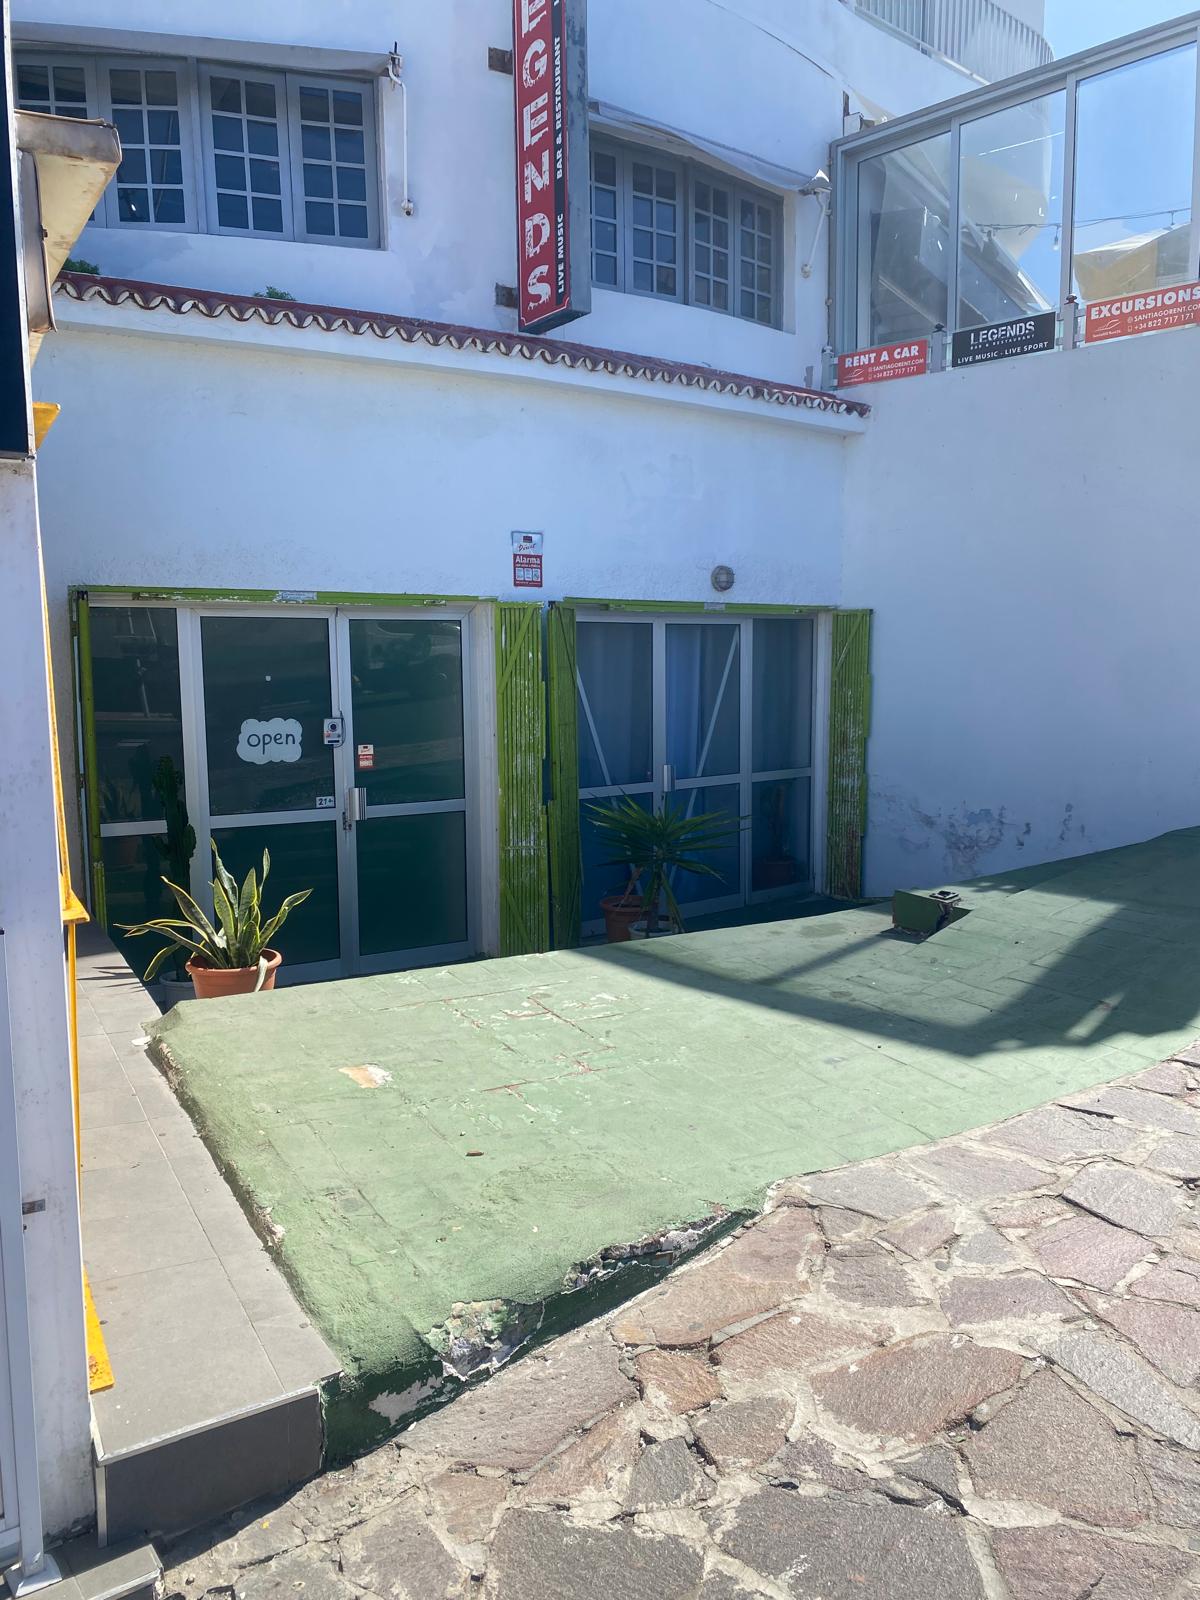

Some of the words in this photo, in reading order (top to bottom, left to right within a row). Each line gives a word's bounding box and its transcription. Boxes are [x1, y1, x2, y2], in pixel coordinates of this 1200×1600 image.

[554, 36, 562, 130] RESTAURANT
[556, 132, 562, 145] &
[1090, 285, 1200, 320] EXCURSIONS
[1147, 318, 1161, 328] 822
[1164, 314, 1178, 325] 717
[1181, 312, 1194, 321] 171
[970, 320, 1035, 345] LEGENDS
[845, 353, 876, 368] RENT
[880, 351, 889, 362] A
[893, 345, 919, 359] CAR
[957, 355, 973, 364] LIVE
[975, 350, 998, 360] MUSIC
[1005, 346, 1021, 355] LIVE
[1023, 341, 1049, 352] SPORT
[515, 555, 541, 564] Alarma
[247, 733, 296, 755] open
